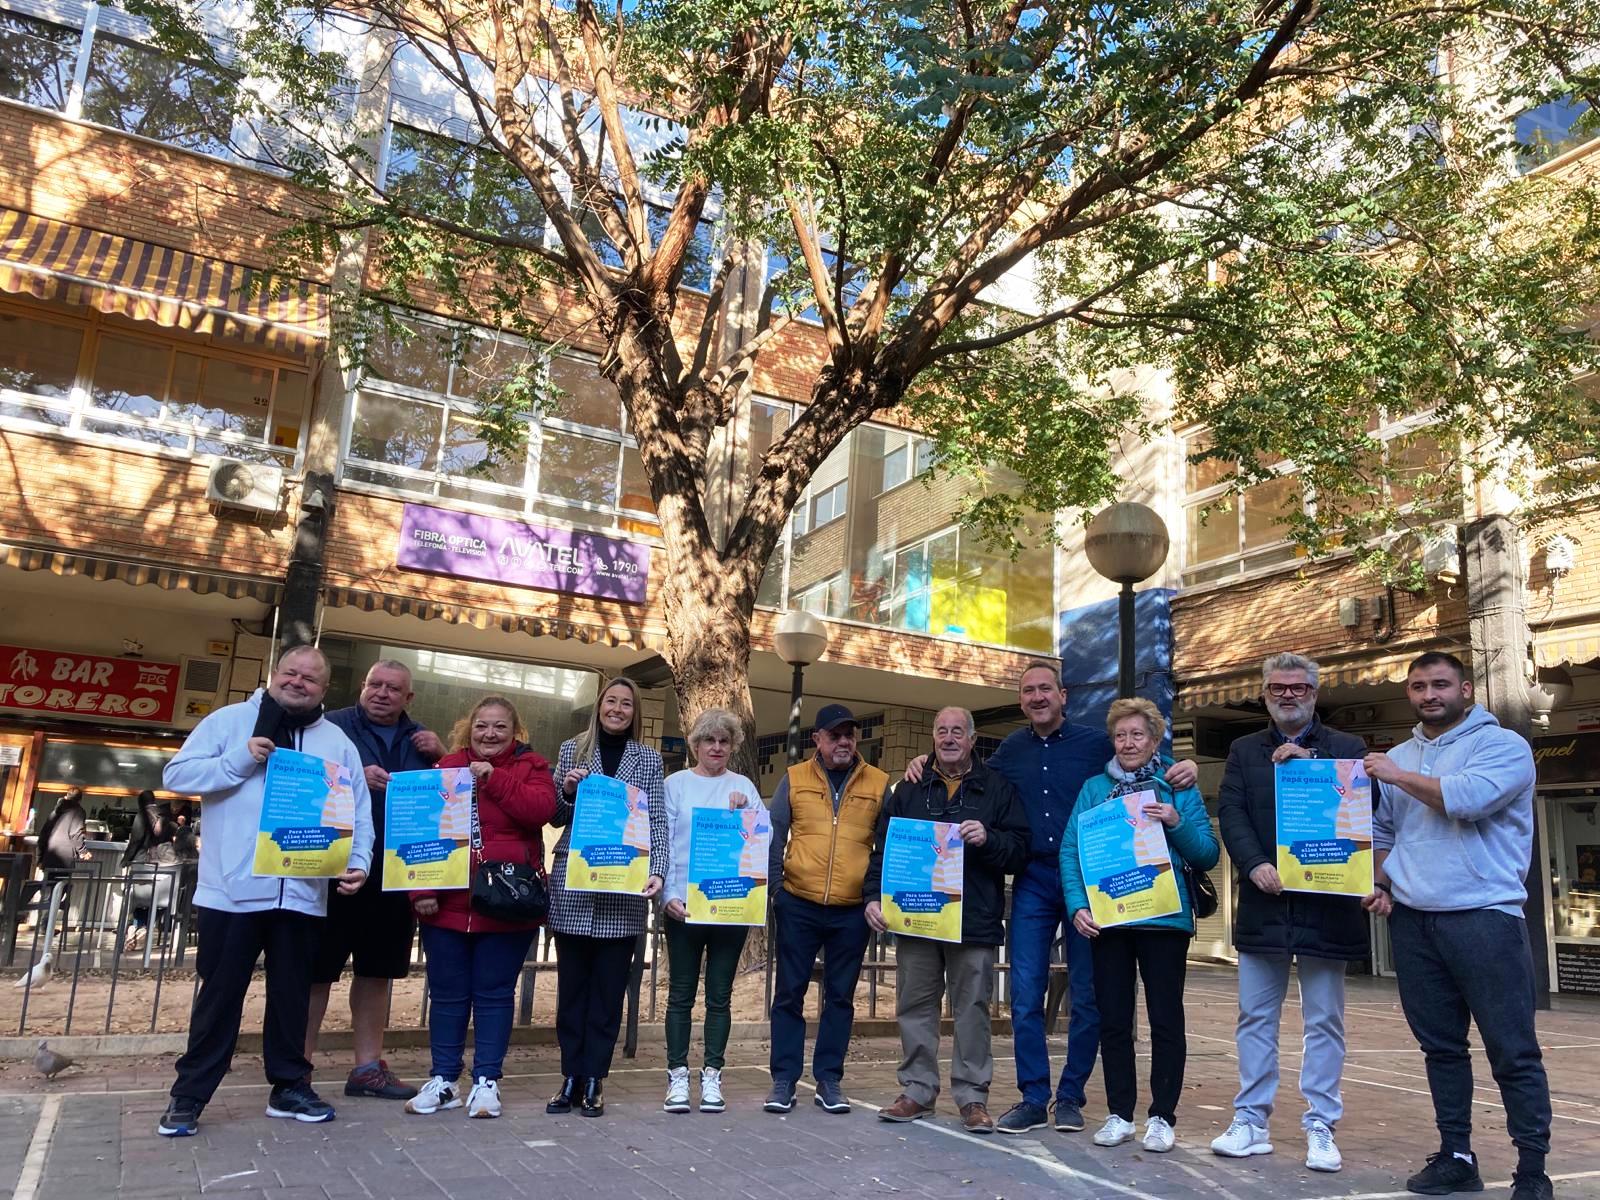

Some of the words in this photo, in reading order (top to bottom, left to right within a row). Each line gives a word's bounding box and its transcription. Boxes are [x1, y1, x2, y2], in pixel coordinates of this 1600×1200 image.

[414, 529, 446, 543] FIBRA
[499, 536, 584, 568] AVATEL
[549, 563, 584, 575] TELECOM
[612, 560, 638, 574] 1790
[51, 657, 114, 688] BAR
[138, 672, 168, 685] FPG
[0, 683, 160, 717] TORERO
[273, 763, 295, 773] Papá
[295, 767, 325, 777] genial
[1281, 775, 1302, 784] Papá
[1303, 776, 1334, 785] genial
[392, 784, 412, 793] Papá
[412, 784, 440, 792] genial
[601, 790, 625, 800] genial
[696, 821, 713, 829] Papá
[714, 823, 740, 831] genial
[908, 835, 932, 843] genial
[1125, 870, 1140, 878] todos
[1125, 874, 1146, 883] tenemos
[1133, 878, 1152, 887] regalo
